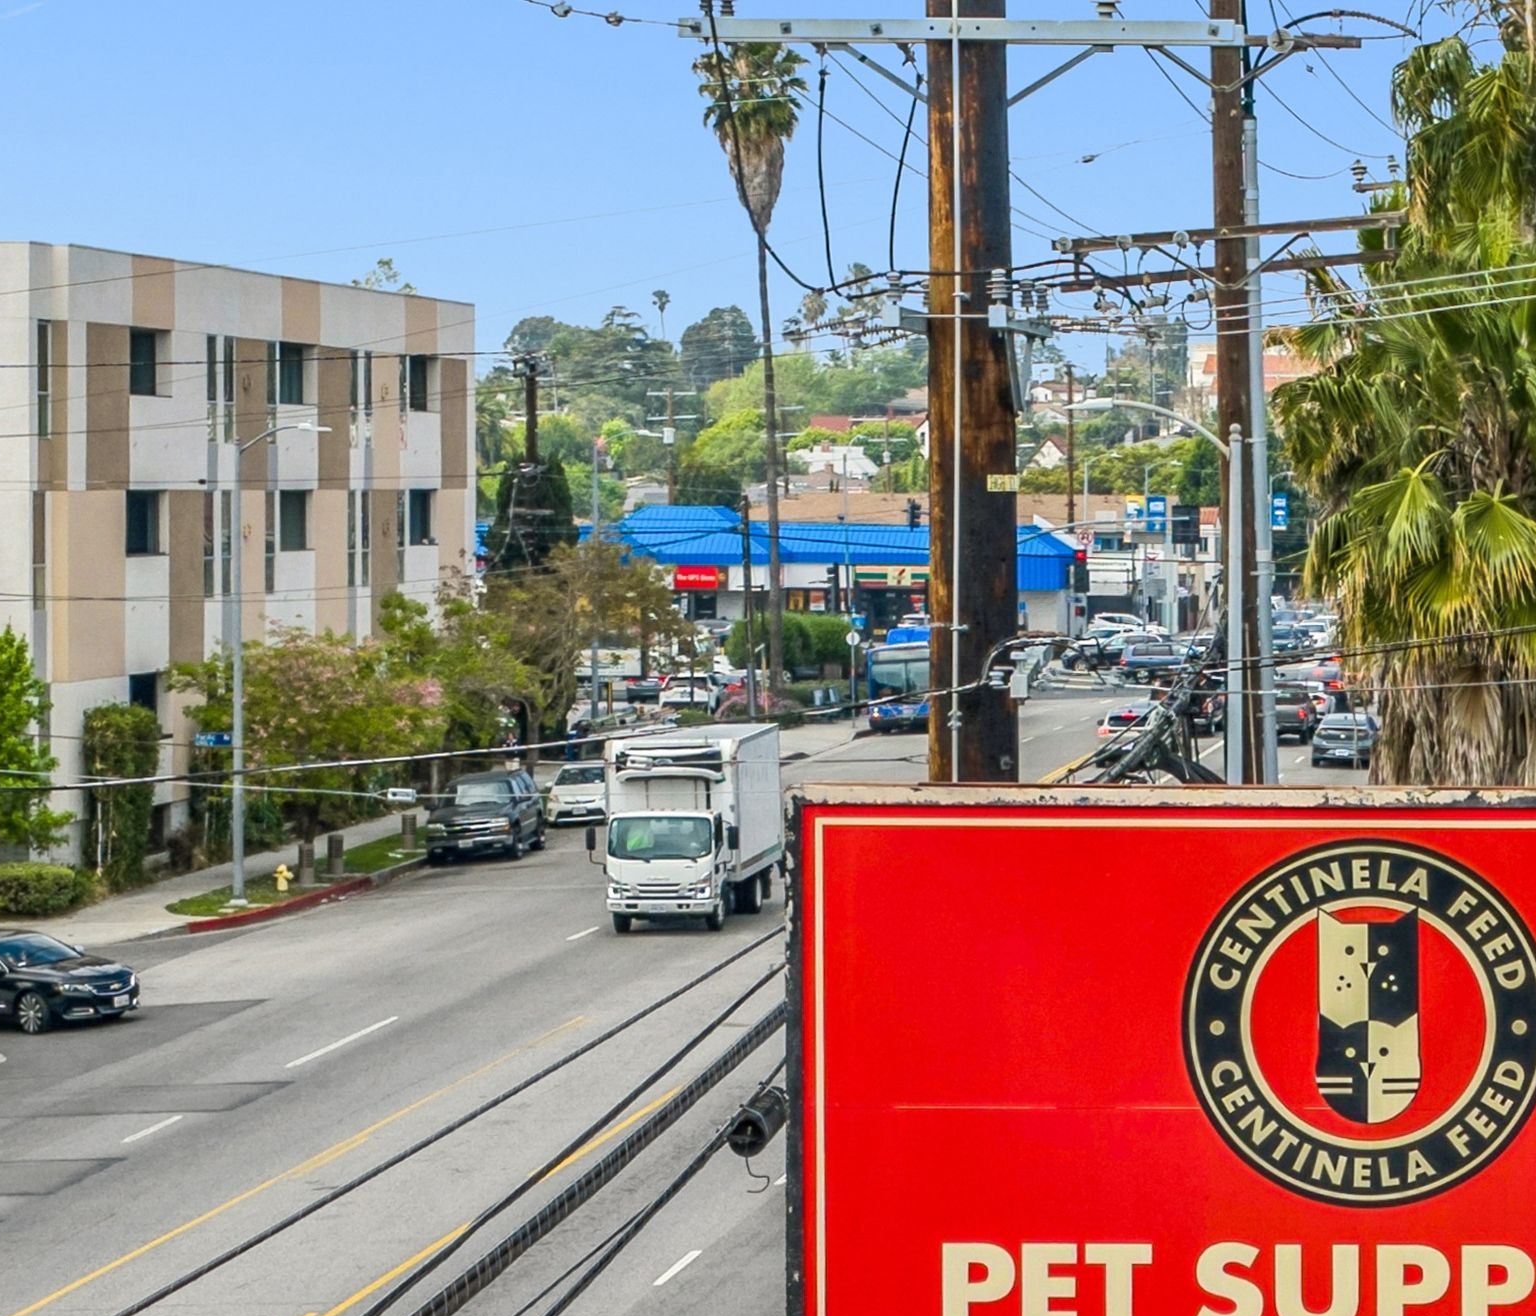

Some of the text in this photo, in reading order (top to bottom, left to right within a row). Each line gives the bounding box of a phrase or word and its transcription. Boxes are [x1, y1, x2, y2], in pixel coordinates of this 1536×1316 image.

[1209, 858, 1527, 990] CENTINELA FEED
[1211, 1060, 1526, 1189] CENTINELA FEED
